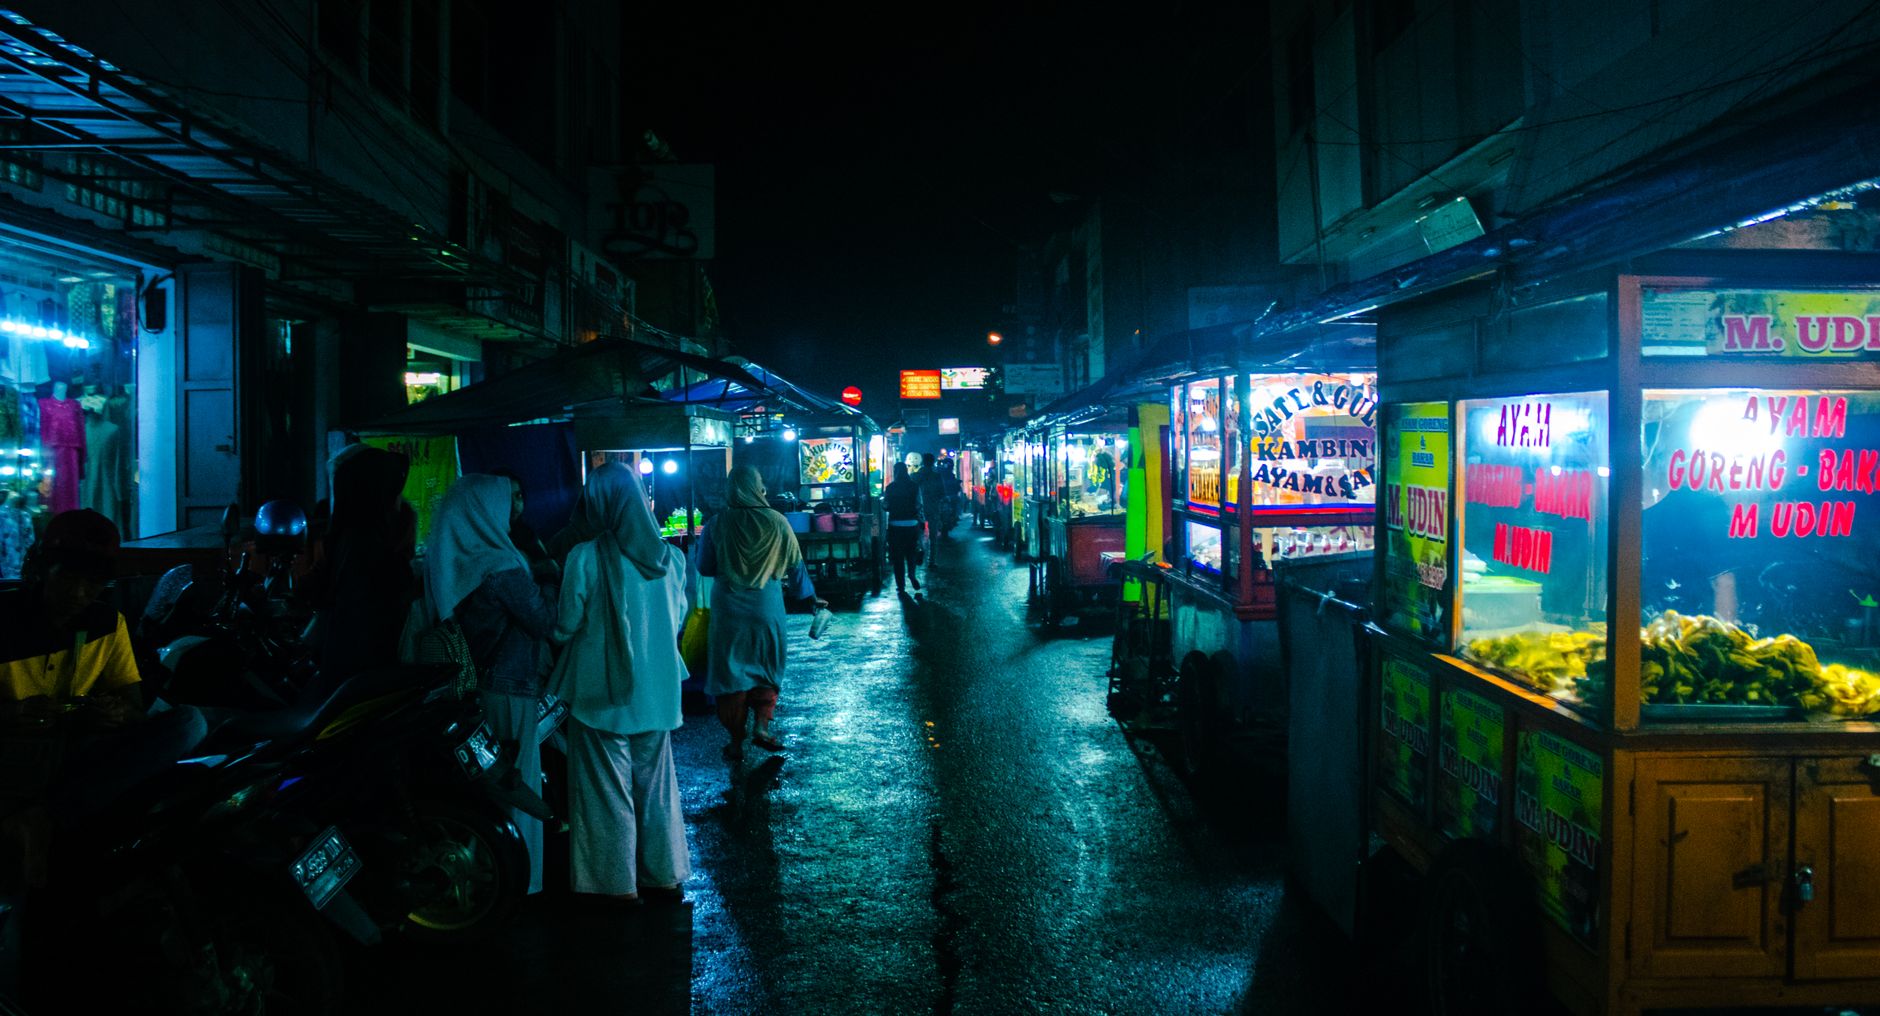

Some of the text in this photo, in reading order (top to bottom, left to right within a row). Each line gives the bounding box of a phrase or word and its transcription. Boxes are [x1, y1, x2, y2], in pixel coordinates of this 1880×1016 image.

[1723, 315, 1785, 351] M.
[1253, 387, 1310, 440] SATE
[1333, 384, 1377, 430] GUL
[1497, 403, 1551, 447] AYAM
[1743, 396, 1847, 437] AYAM
[1257, 439, 1377, 462] KAMBIN
[1668, 449, 1786, 493] GORENG
[1818, 449, 1880, 494] BAK
[1407, 485, 1447, 541] UDIN
[1729, 501, 1856, 538] M UDIN
[1545, 806, 1599, 870] UDIN
